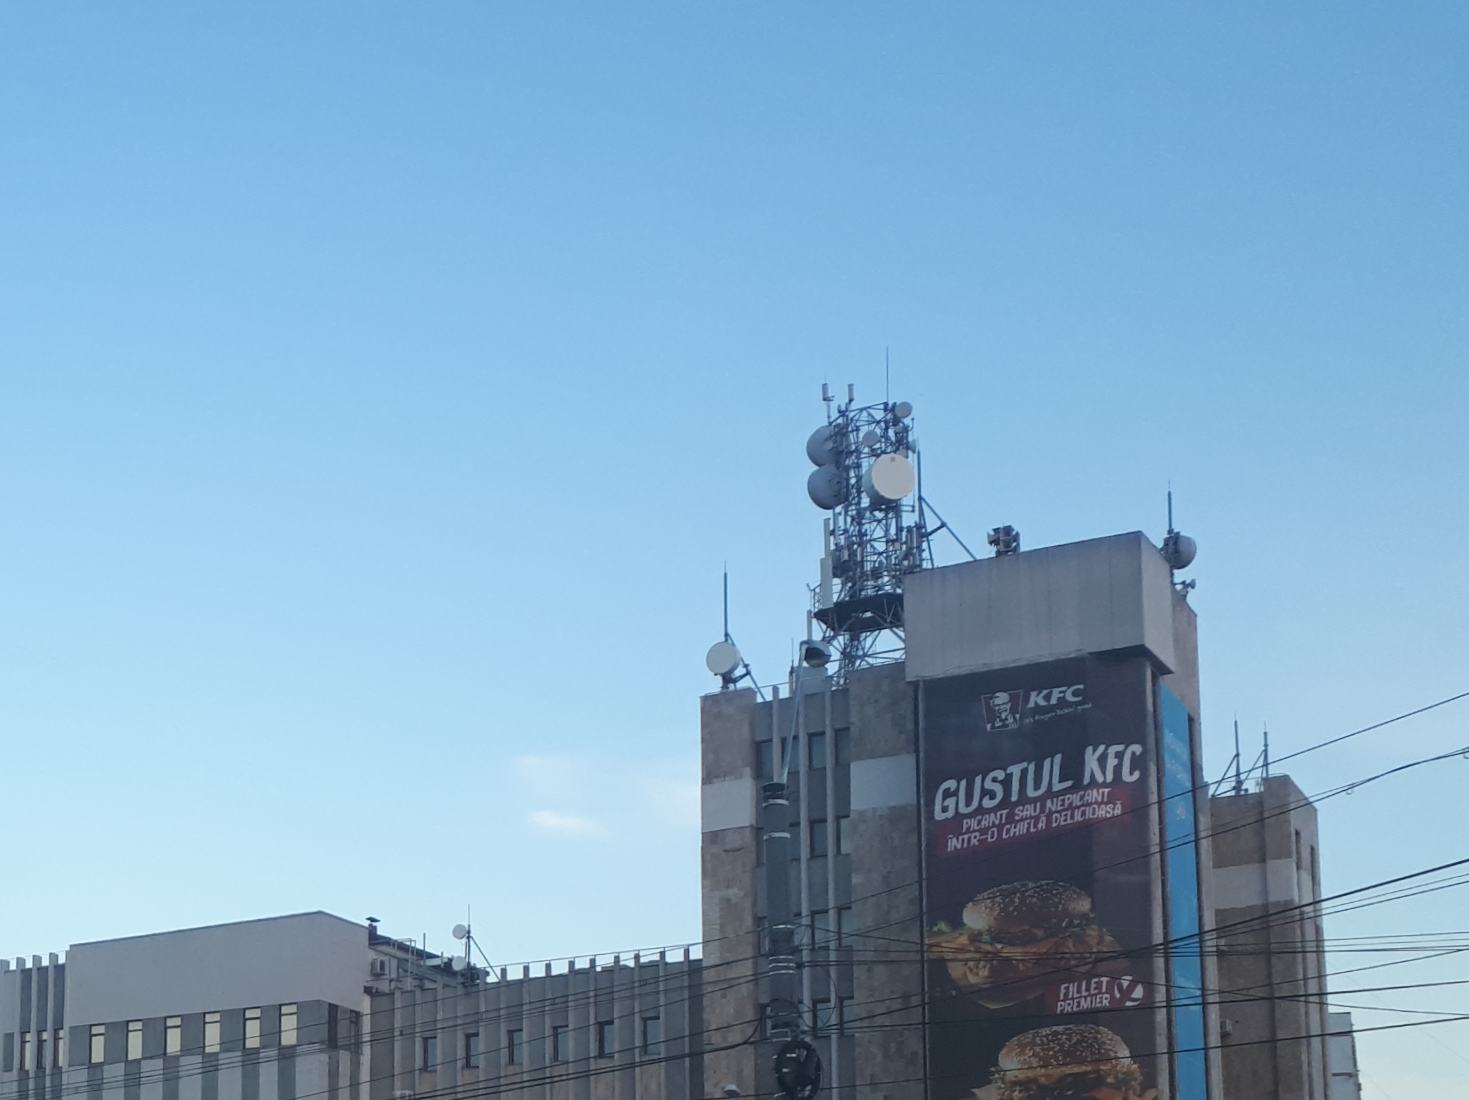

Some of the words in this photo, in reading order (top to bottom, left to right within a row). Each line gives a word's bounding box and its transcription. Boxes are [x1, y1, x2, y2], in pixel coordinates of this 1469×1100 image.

[1026, 684, 1085, 709] KFC
[933, 753, 1074, 821] GUSTUL
[1083, 744, 1143, 787] KFC
[946, 828, 998, 852] ÎNTR-O
[1002, 813, 1046, 839] CHIFLĂ
[1051, 800, 1122, 828] DELICIOASĂ
[962, 809, 1010, 833] PICANT
[1014, 801, 1041, 821] SAU
[1044, 787, 1111, 816] NEPICANT
[1056, 993, 1111, 1015] PREMIER
[1059, 977, 1109, 1001] FILLET
